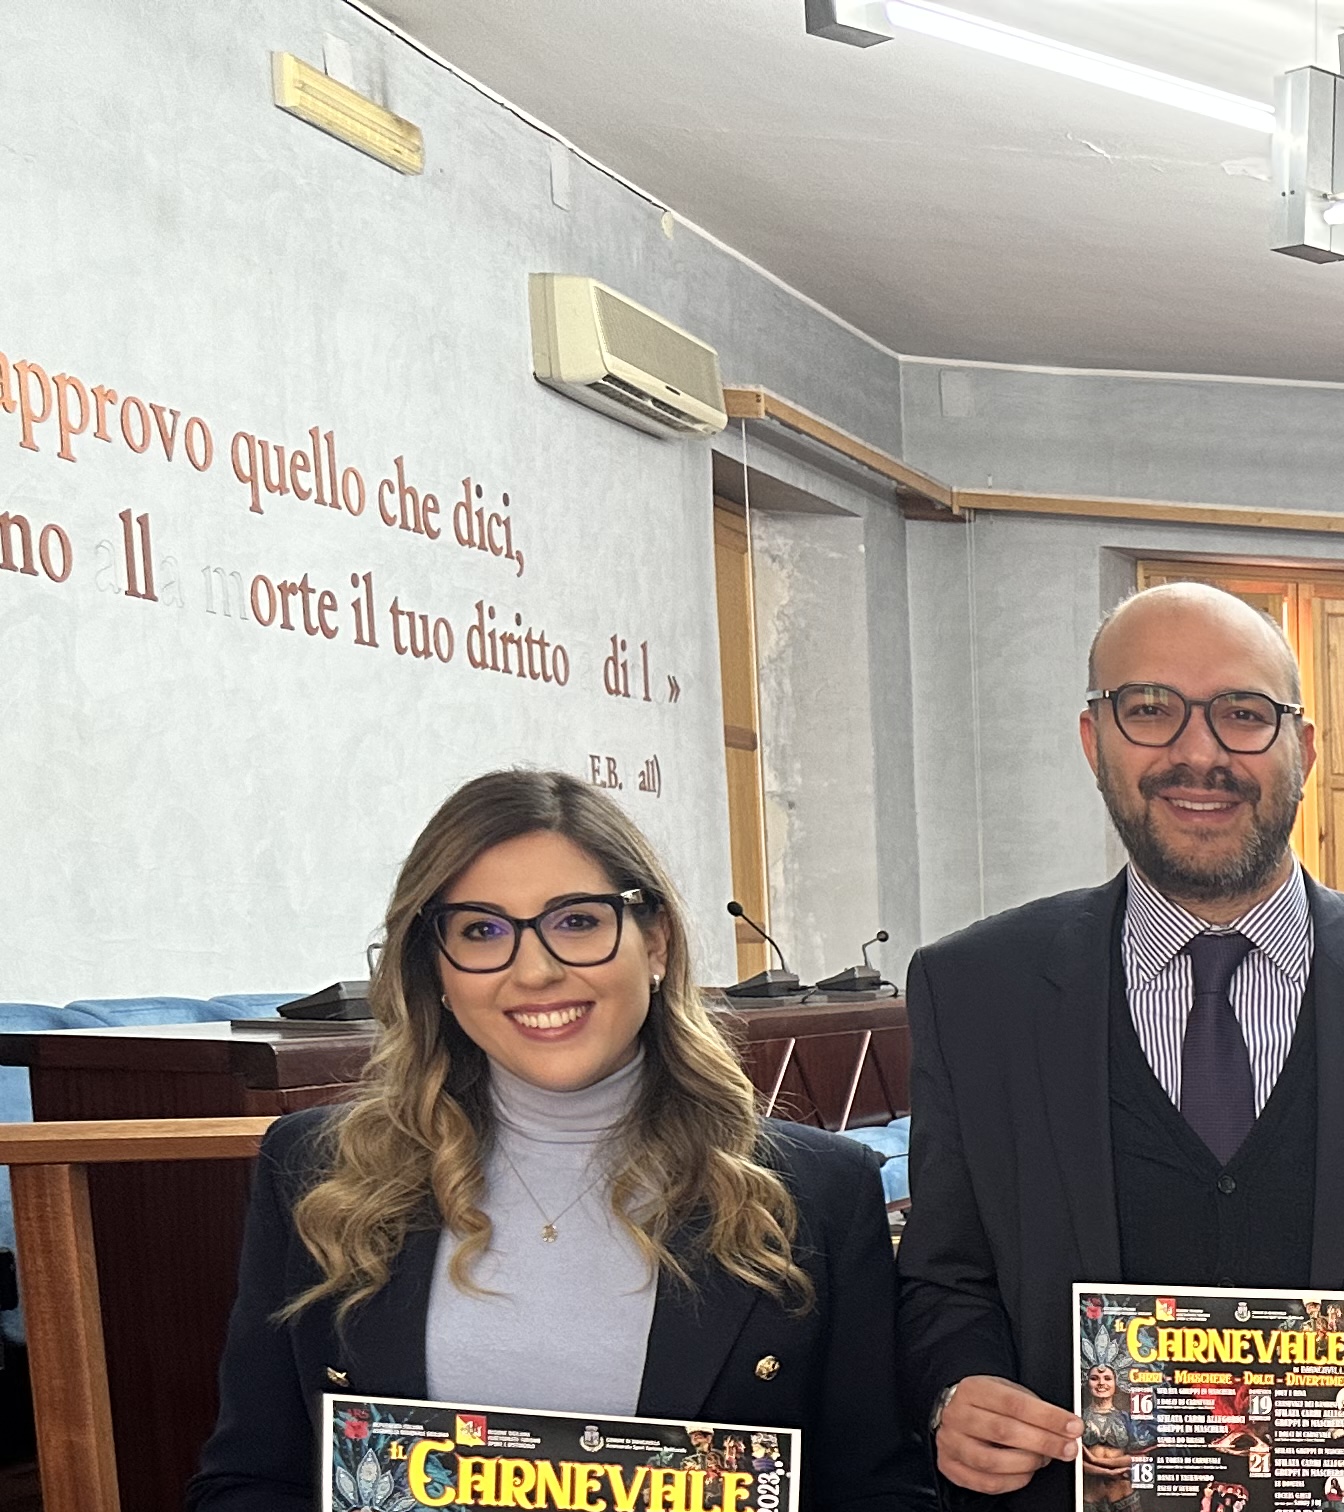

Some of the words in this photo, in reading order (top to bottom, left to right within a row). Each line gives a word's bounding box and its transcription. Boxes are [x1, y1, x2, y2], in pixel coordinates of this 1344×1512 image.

[231, 425, 366, 516] quello
[378, 456, 441, 541] che
[453, 476, 524, 576] dici,
[351, 571, 379, 649] il
[389, 595, 454, 664] tuo
[467, 600, 569, 688] diritto
